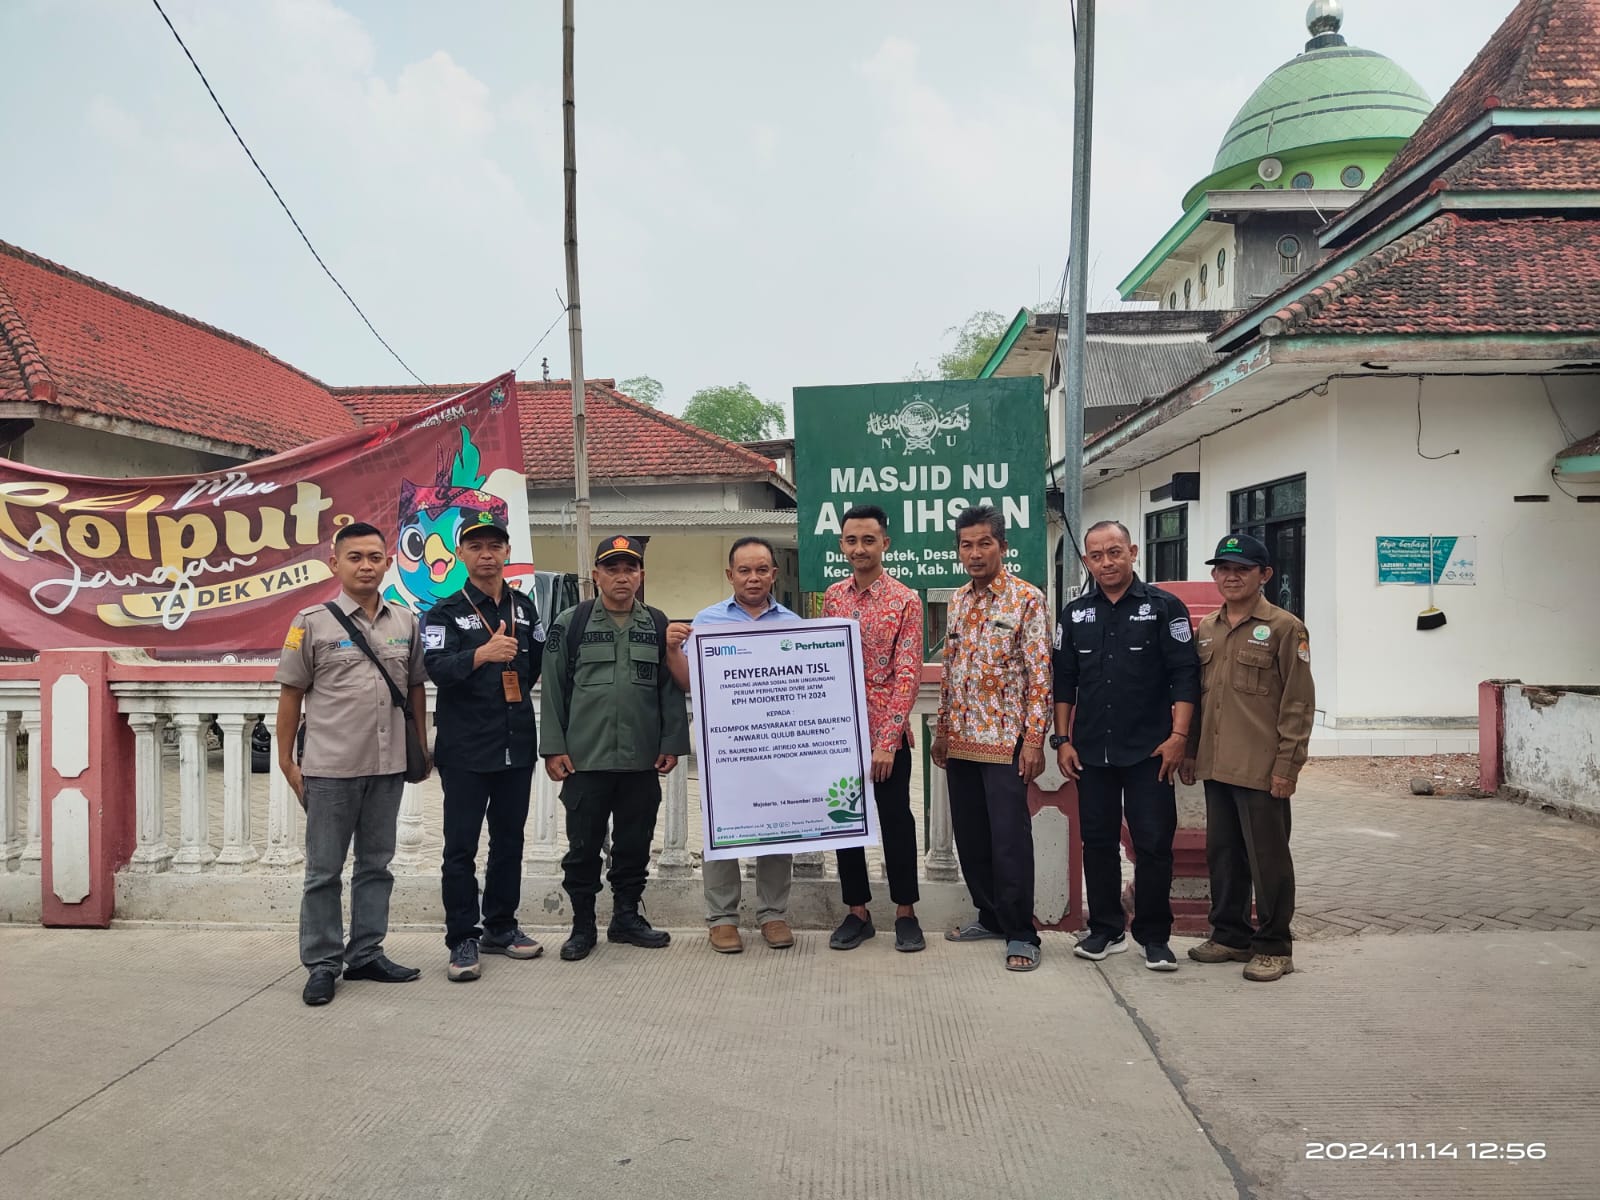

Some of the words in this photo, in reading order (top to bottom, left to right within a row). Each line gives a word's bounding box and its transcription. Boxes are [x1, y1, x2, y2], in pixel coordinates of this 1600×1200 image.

[881, 438, 892, 449] N
[946, 435, 957, 447] U
[830, 465, 952, 493] MASJID
[962, 463, 1009, 490] NU
[172, 472, 281, 511] Mau
[903, 495, 1030, 533] IHSN
[0, 482, 333, 584] Golput
[923, 548, 957, 561] Desa
[824, 566, 853, 578] Kec.
[917, 562, 948, 576] Kab.
[151, 593, 186, 612] YA
[198, 582, 251, 607] DEK
[260, 564, 310, 593] YA!!
[705, 645, 737, 657] BUMN
[795, 640, 845, 651] Perhutani
[723, 664, 803, 680] PENYERAHAN
[806, 662, 830, 674] TJSL
[732, 697, 747, 706] KPH
[748, 694, 796, 704] MOJOKERTO
[808, 692, 826, 700] 2024
[710, 724, 750, 734] KELOMPOK
[750, 720, 797, 731] MASYARAKAT
[818, 716, 852, 726] BAURENO
[733, 732, 769, 742] ANWARUL
[771, 730, 795, 740] QULUB
[796, 728, 830, 737] BAURENO
[812, 740, 847, 748] MOJOKERTO
[740, 754, 772, 762] PERBAIKAN
